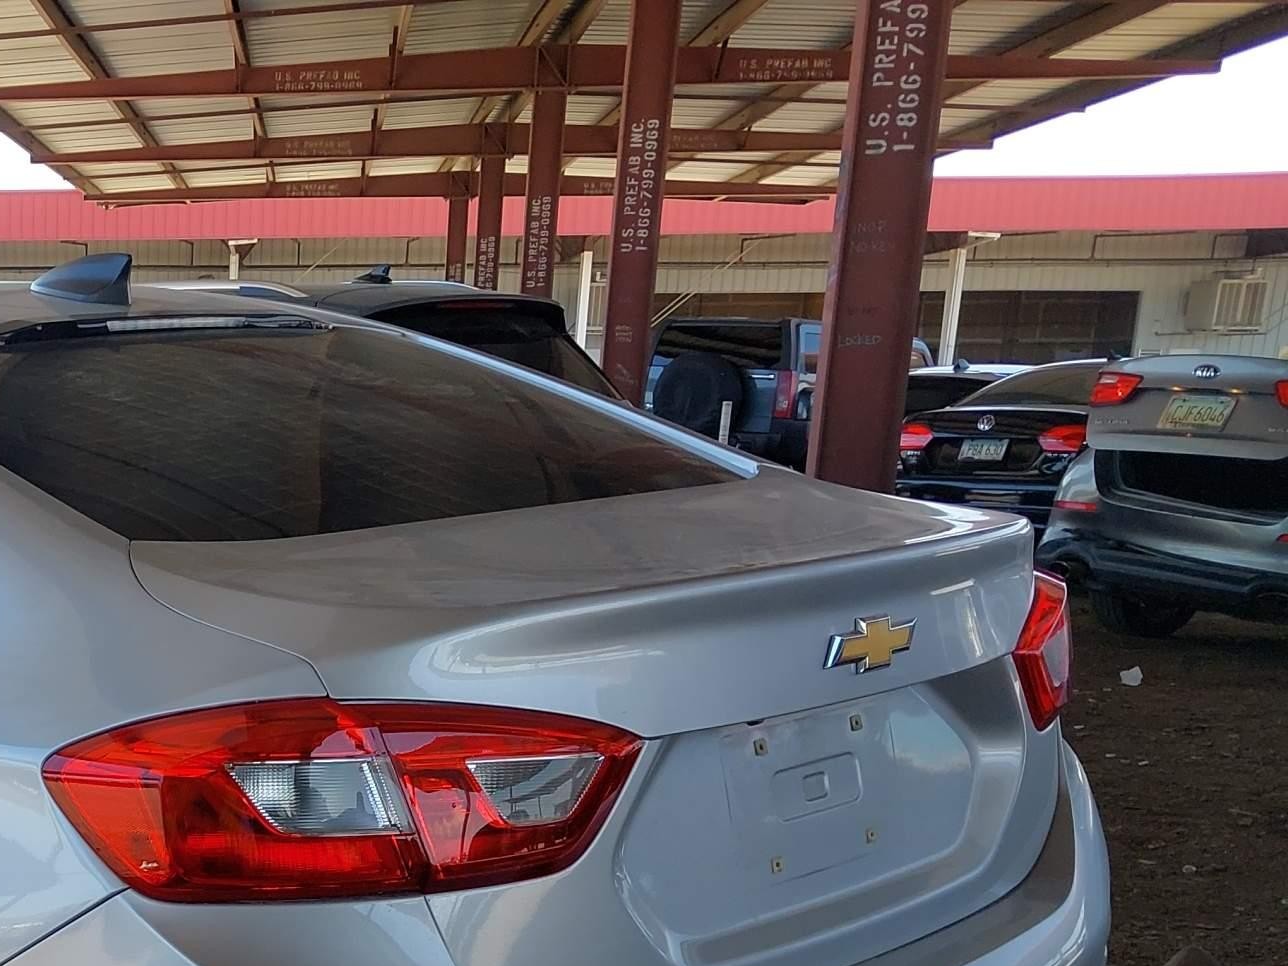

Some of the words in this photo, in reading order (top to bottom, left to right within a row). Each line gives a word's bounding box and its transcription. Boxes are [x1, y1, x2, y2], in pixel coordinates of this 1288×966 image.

[629, 118, 645, 148] INC.
[864, 104, 892, 155] U.S.
[623, 155, 641, 215] PREFAB
[635, 119, 660, 251] 1-866-799-0969
[527, 221, 540, 262] PREFAB
[536, 196, 552, 287] 1-866-799-0969
[620, 224, 634, 253] U.S.
